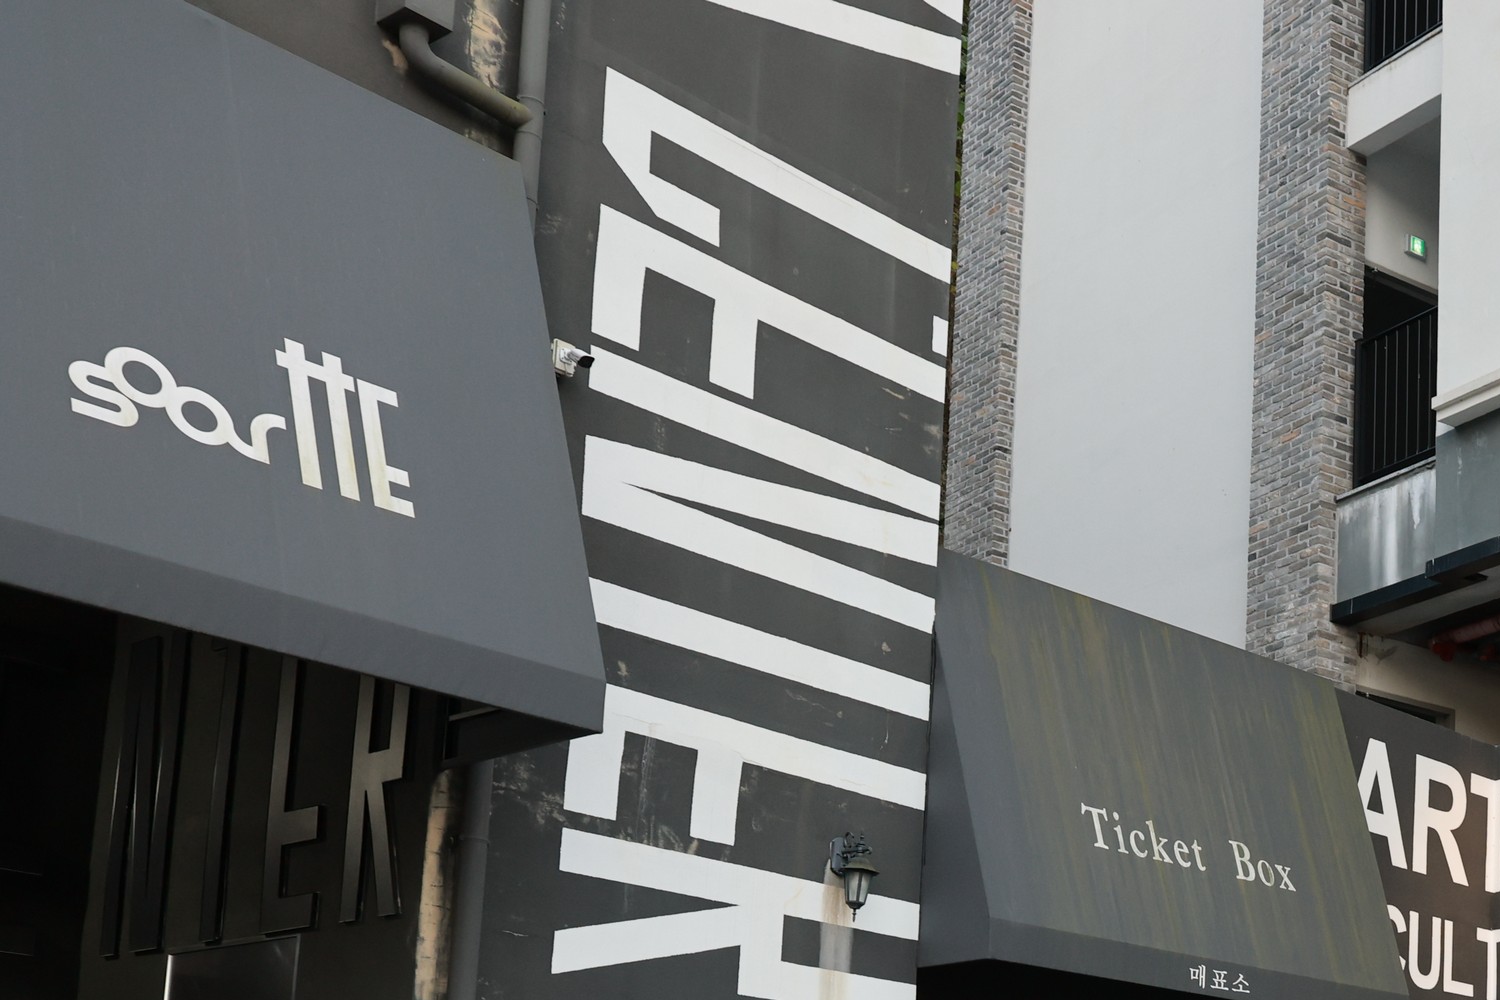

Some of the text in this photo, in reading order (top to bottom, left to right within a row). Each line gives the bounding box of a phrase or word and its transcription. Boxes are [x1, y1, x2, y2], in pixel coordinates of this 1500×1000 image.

[1081, 803, 1296, 892] Ticket Box
[1189, 965, 1250, 994] 매표소
